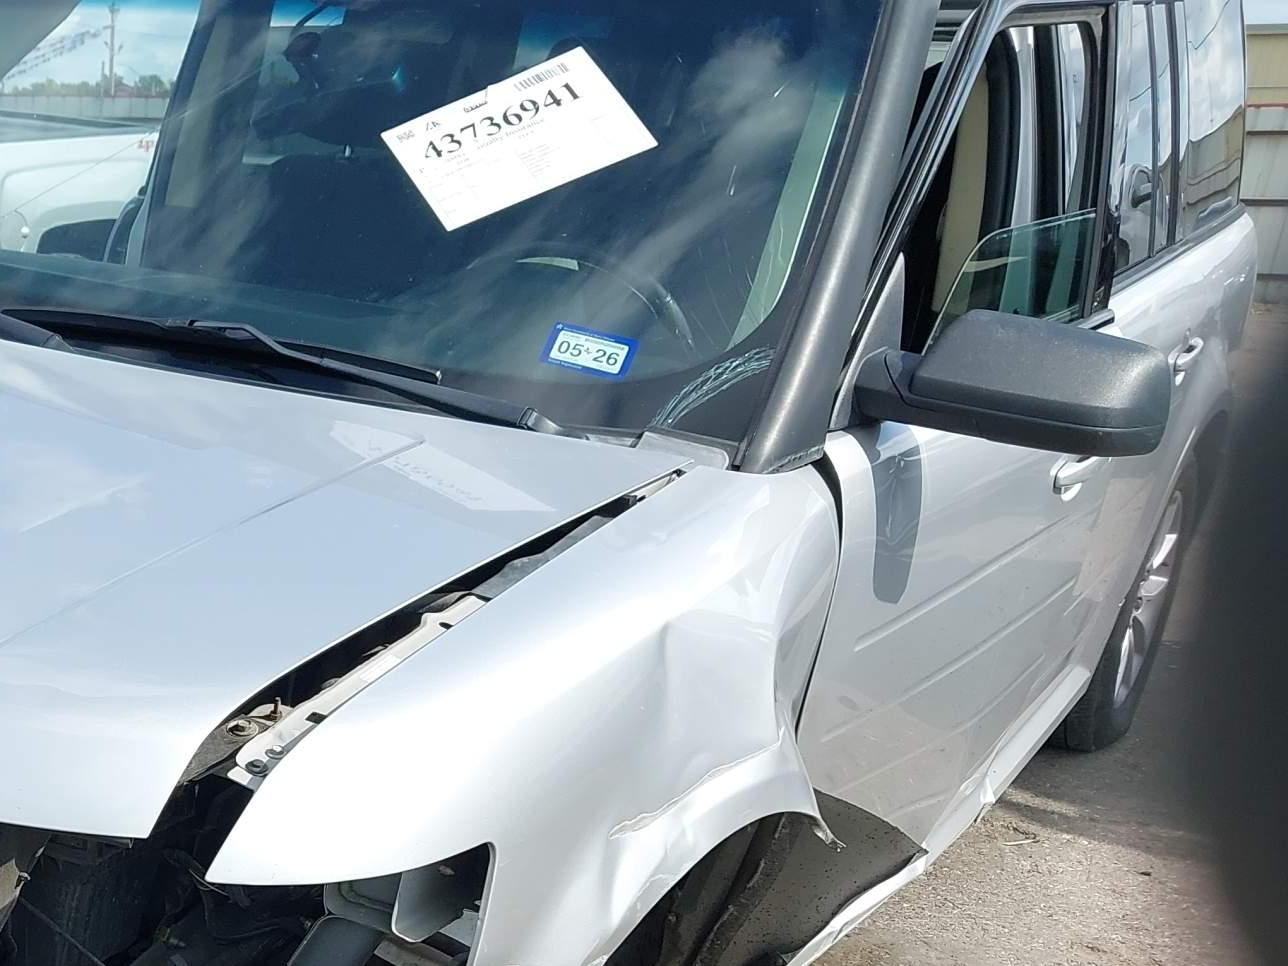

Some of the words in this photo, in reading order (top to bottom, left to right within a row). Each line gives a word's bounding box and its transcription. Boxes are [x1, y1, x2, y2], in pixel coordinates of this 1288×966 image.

[424, 82, 581, 160] 43736941
[556, 340, 585, 358] 05
[591, 348, 620, 366] 26
